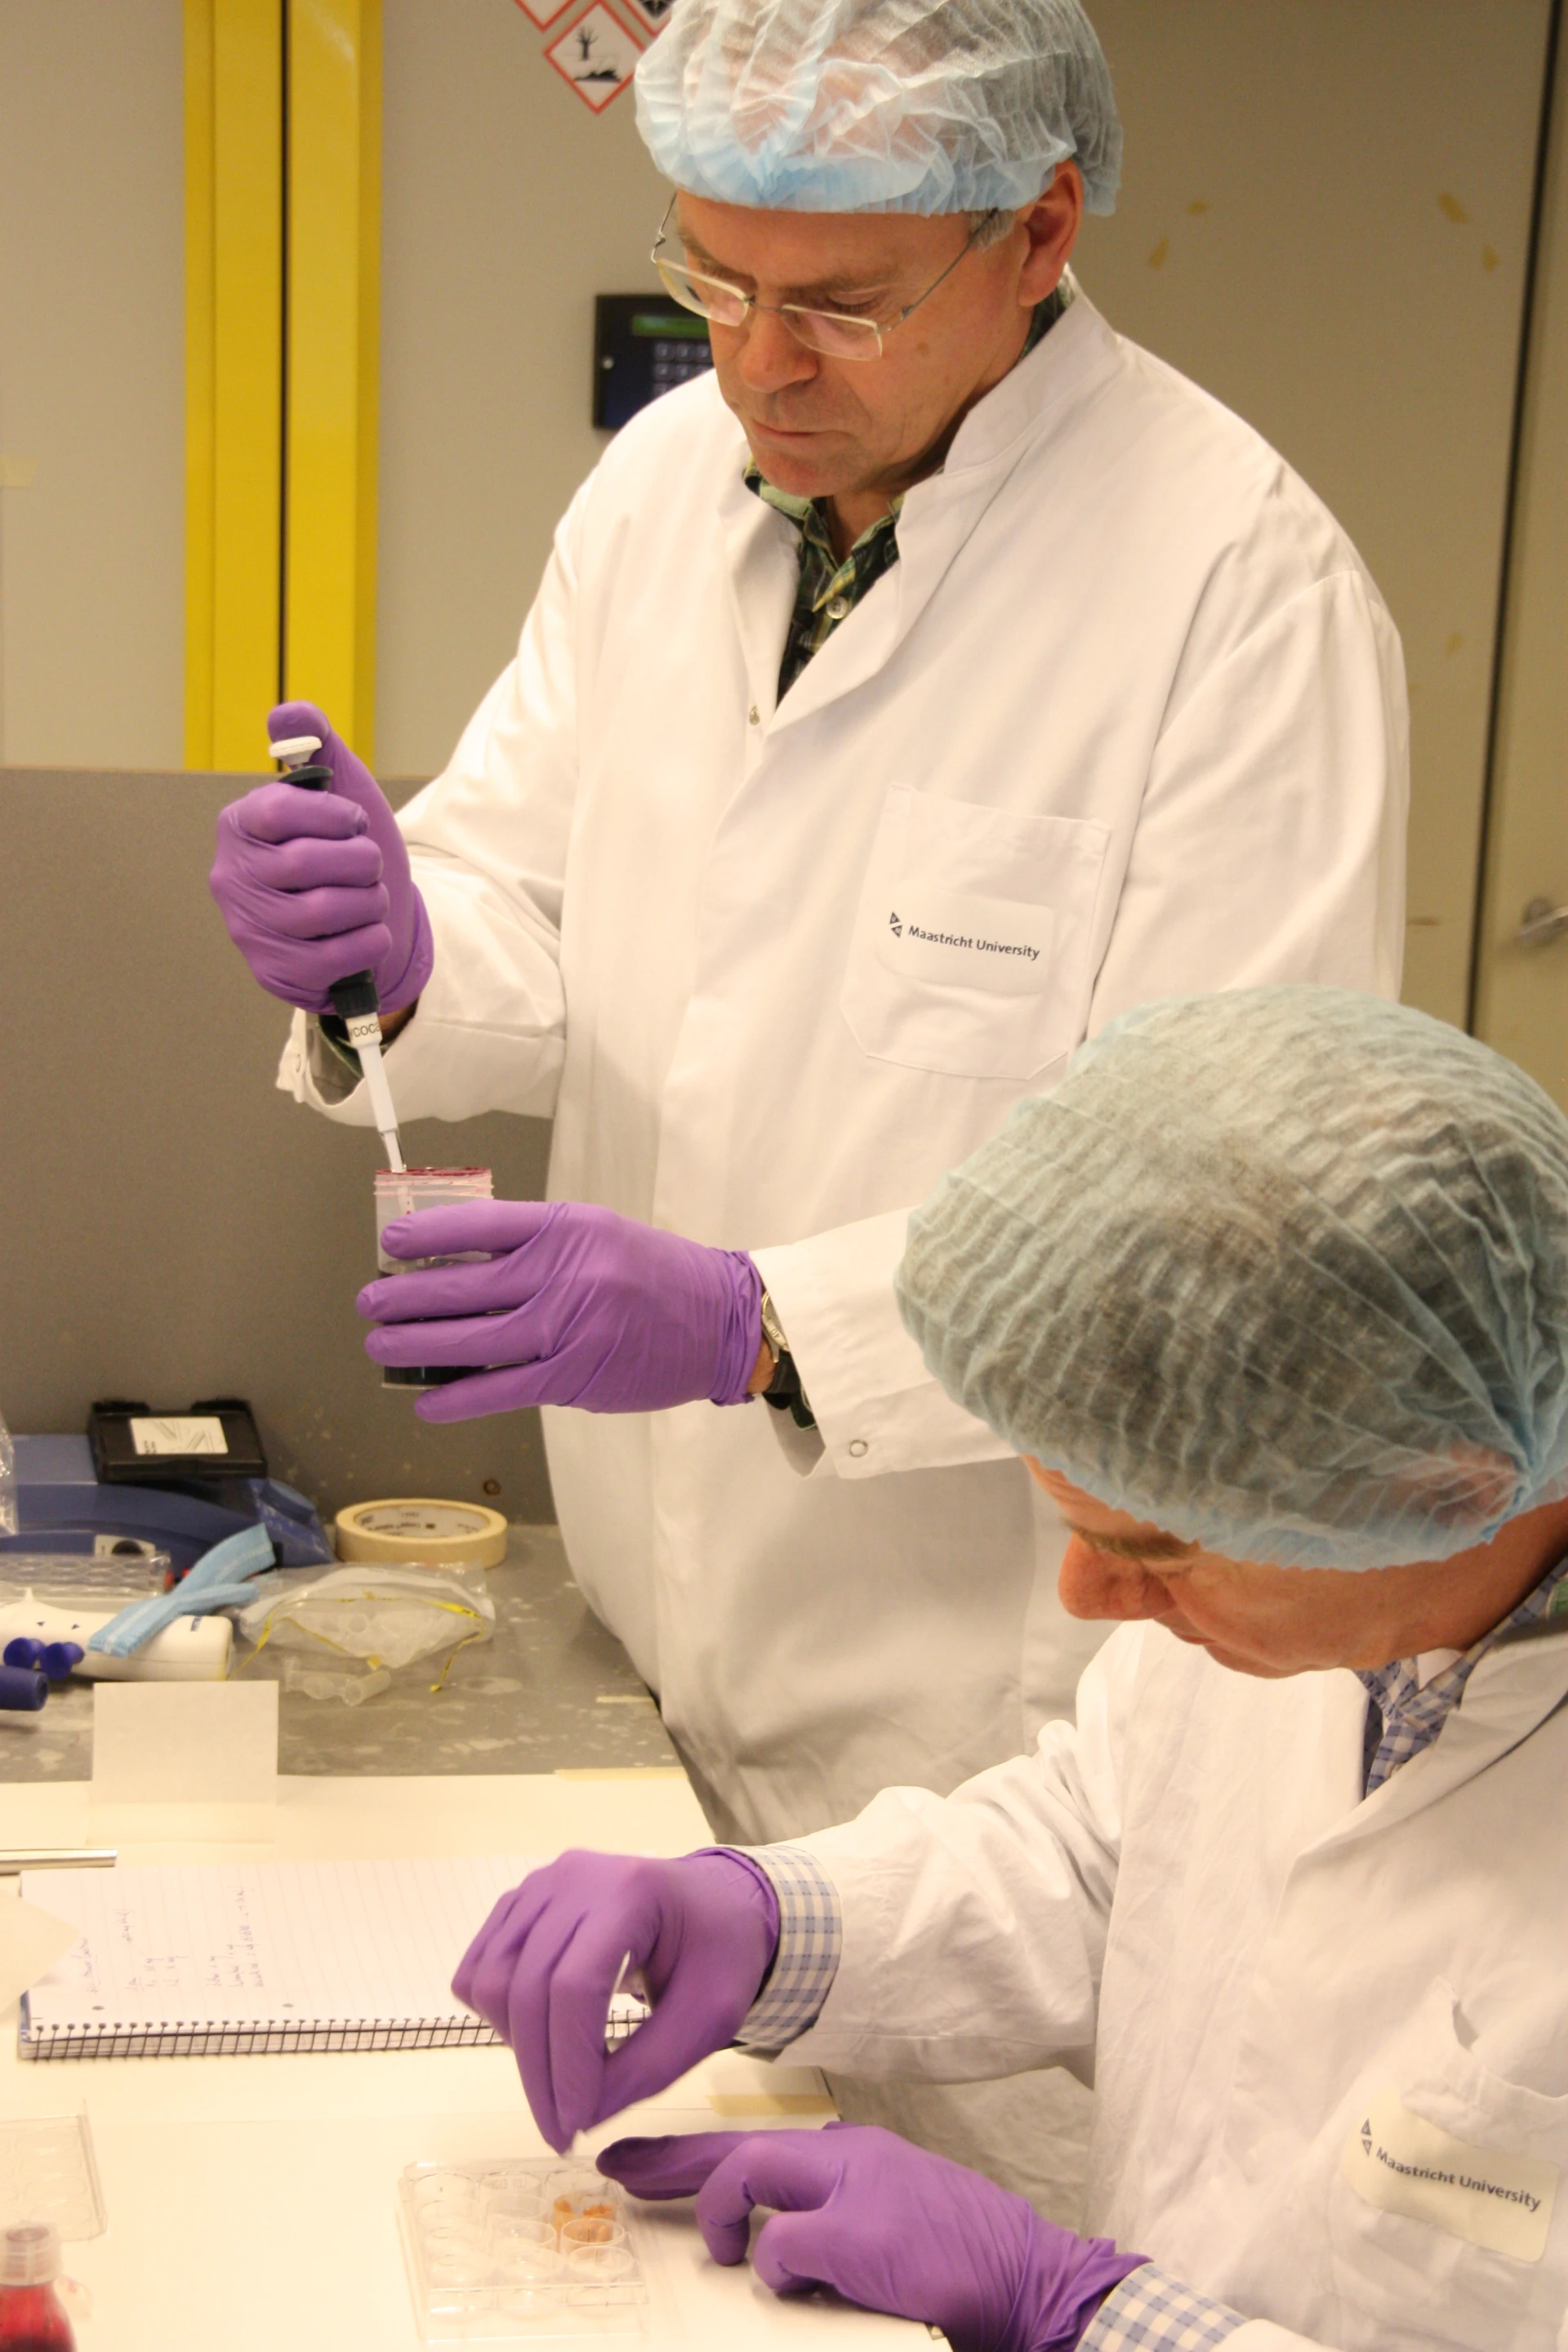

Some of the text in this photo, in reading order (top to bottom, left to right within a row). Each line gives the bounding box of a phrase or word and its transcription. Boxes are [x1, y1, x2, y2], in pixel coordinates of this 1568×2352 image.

[908, 925, 1040, 961] Maastricht University
[1376, 2146, 1542, 2212] Maastricht University
